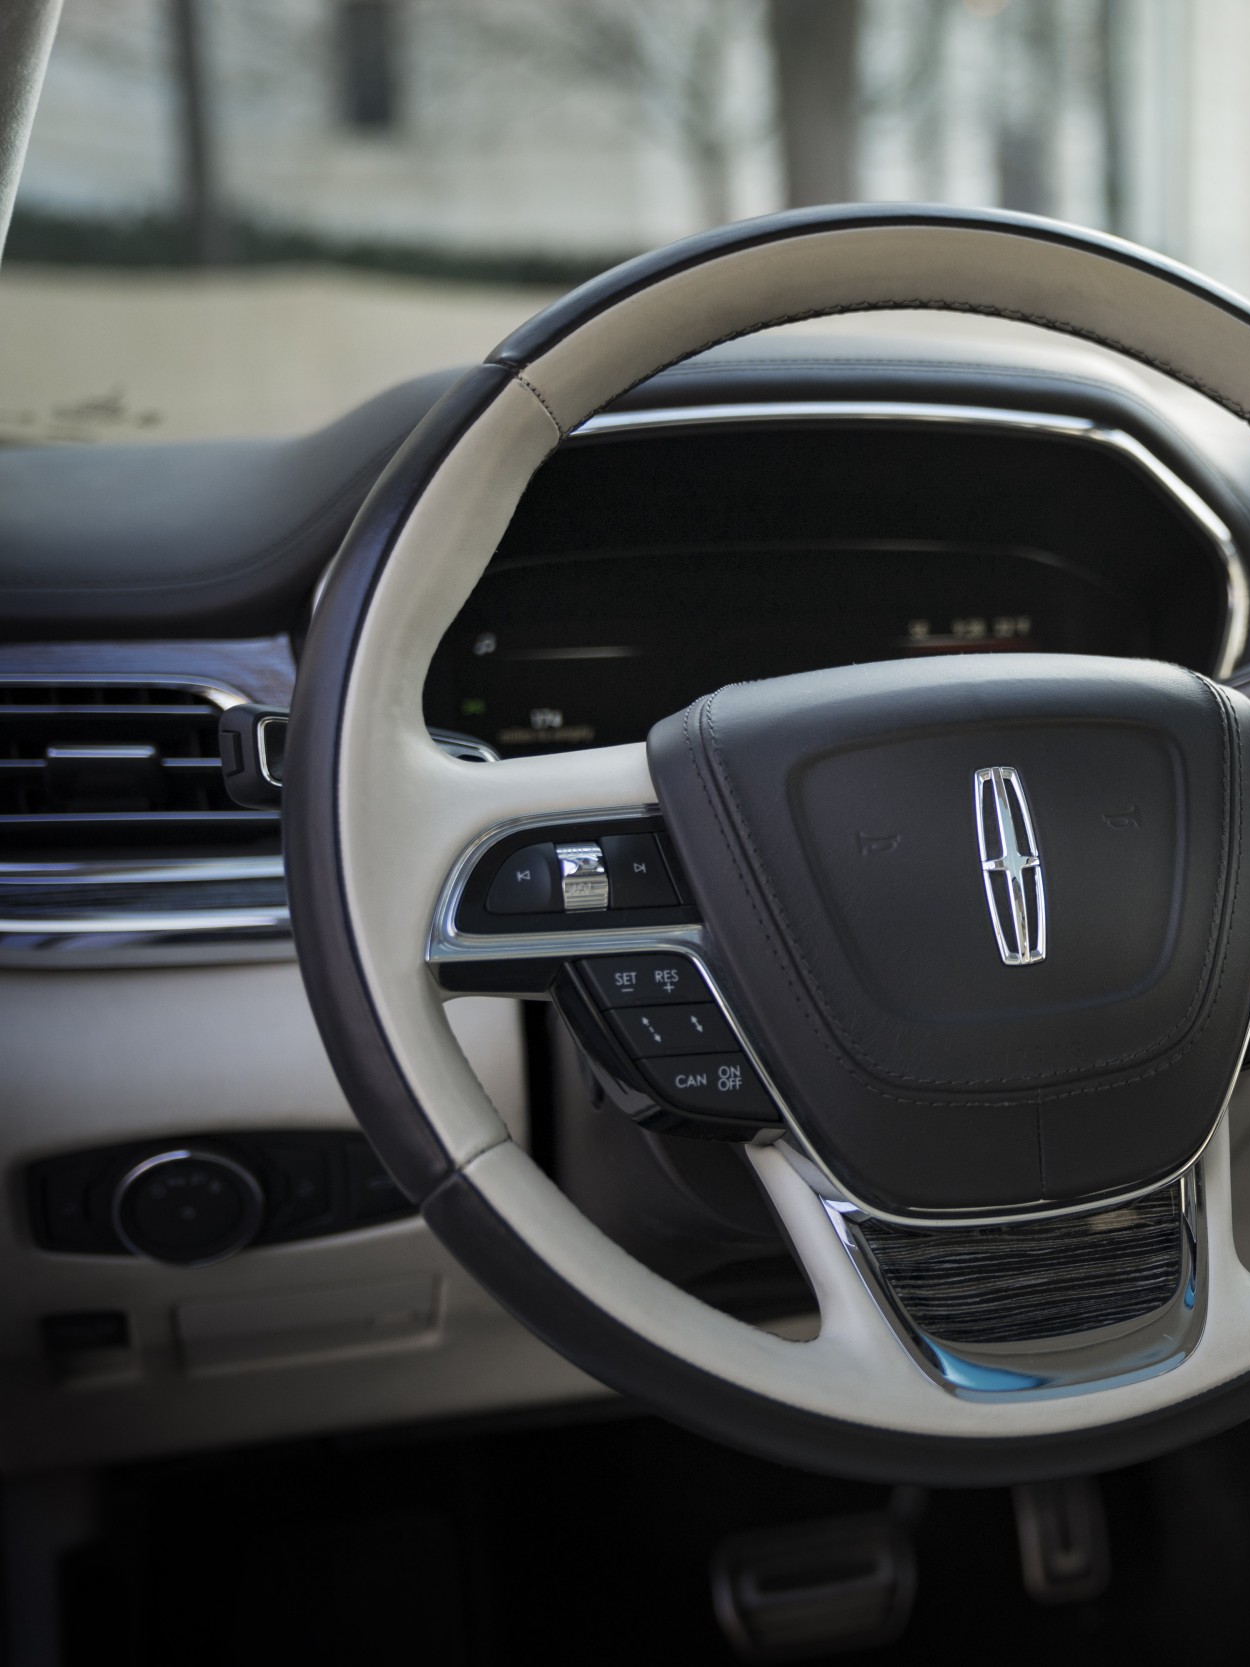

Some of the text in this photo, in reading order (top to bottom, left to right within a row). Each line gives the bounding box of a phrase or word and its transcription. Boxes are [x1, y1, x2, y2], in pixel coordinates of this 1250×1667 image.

[614, 971, 637, 986] SET
[654, 969, 679, 983] RES
[718, 1065, 740, 1079] ON
[675, 1073, 707, 1088] CAN
[718, 1078, 742, 1091] OFF
